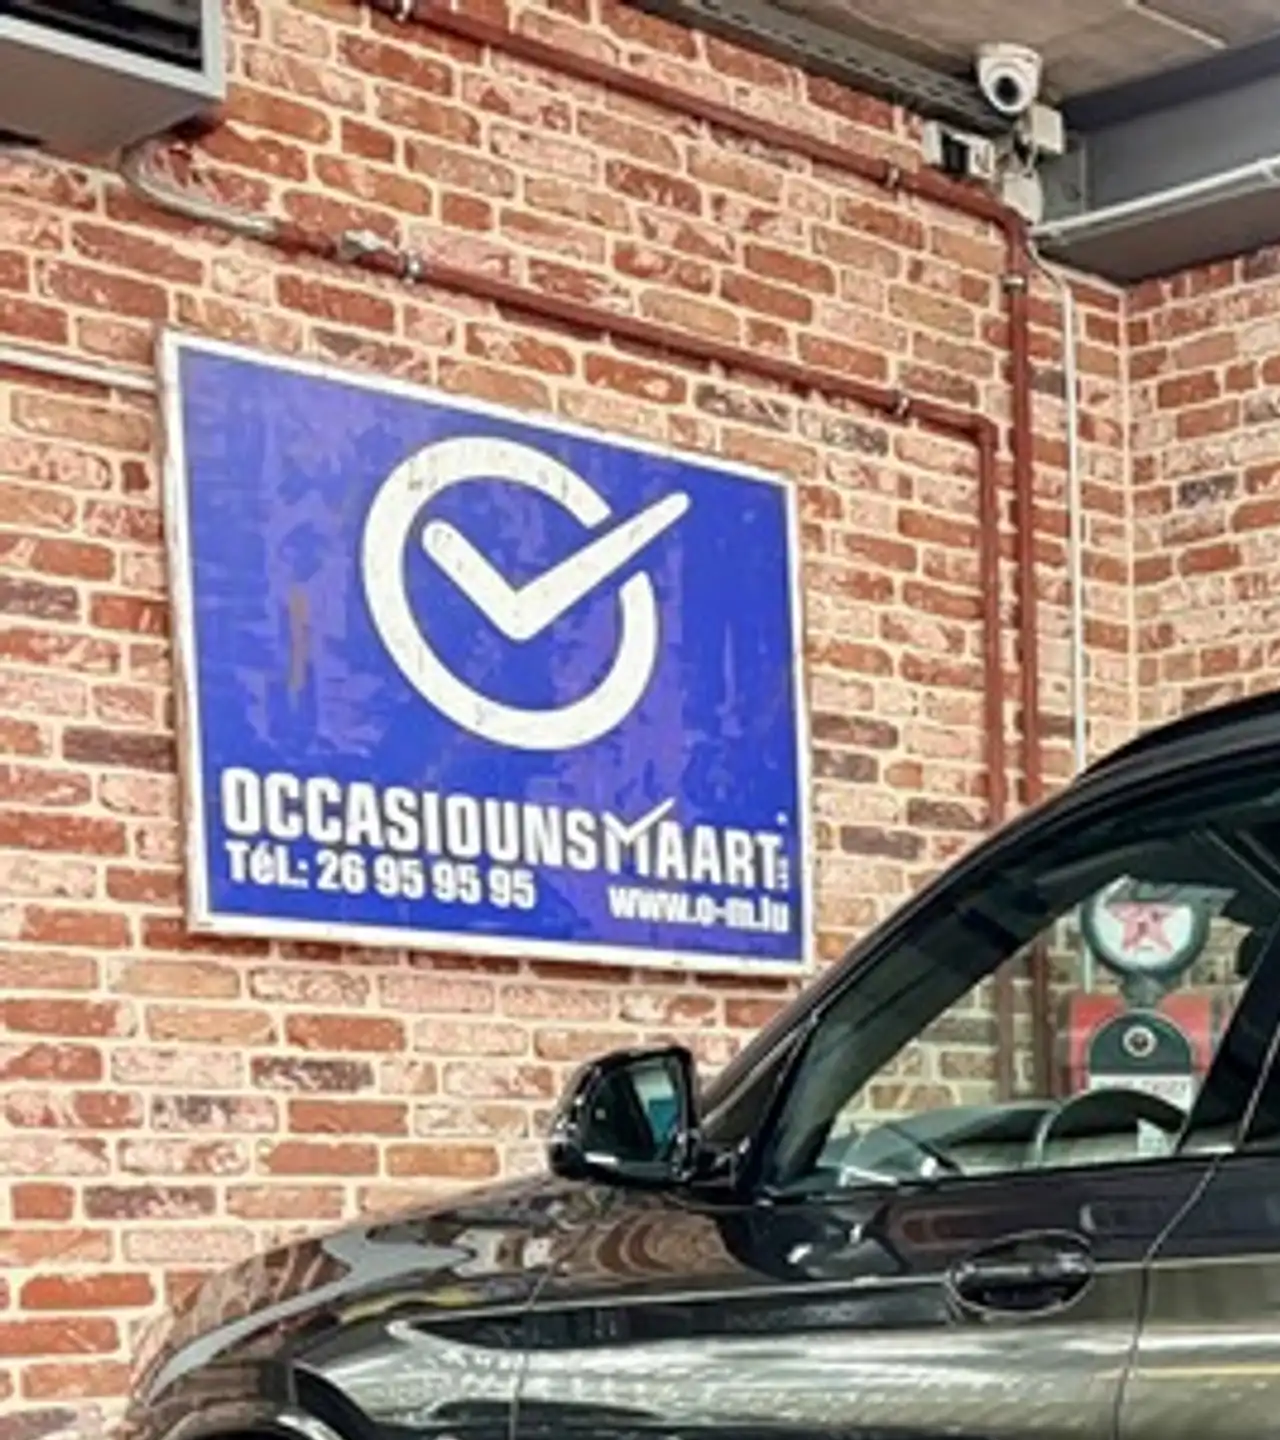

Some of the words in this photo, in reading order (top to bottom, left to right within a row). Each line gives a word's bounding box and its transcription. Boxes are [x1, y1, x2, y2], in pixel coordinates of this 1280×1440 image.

[221, 767, 782, 889] OCCASIOUNSMAART
[316, 850, 365, 894] 26
[374, 854, 424, 899] 95
[432, 860, 482, 905] 95
[488, 866, 536, 910] 95
